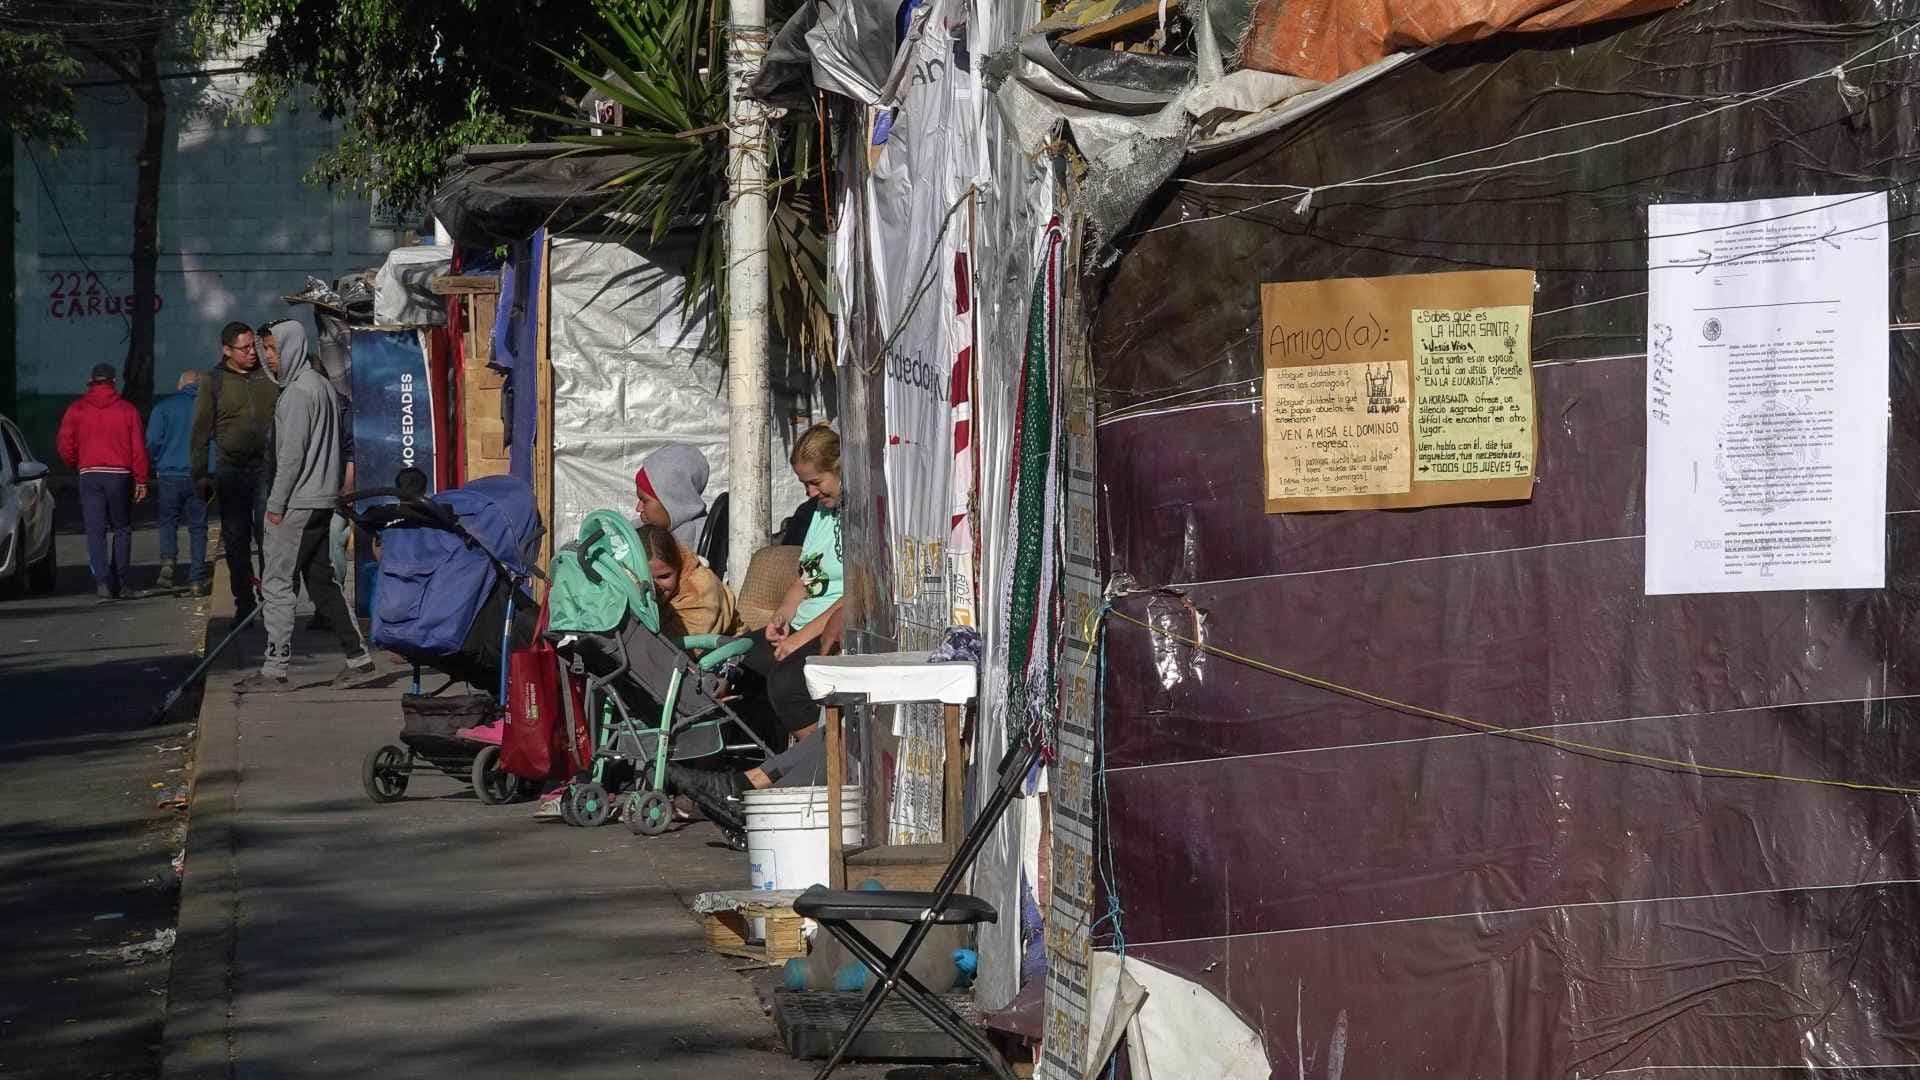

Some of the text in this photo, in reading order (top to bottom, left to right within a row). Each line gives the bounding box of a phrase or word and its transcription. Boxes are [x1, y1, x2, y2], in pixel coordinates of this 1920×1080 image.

[50, 271, 100, 299] 222
[1476, 312, 1487, 321] es
[1269, 311, 1389, 360] Amigo(a):
[1431, 324, 1444, 338] LA
[1448, 323, 1476, 338] HORA
[1420, 355, 1428, 365] La
[1440, 377, 1448, 386] LA
[1418, 396, 1428, 405] LA
[1418, 405, 1446, 414] silencio
[1450, 405, 1484, 416] sagrado
[1488, 404, 1504, 415] que
[1442, 415, 1453, 423] de
[1456, 414, 1490, 424] encontrar
[1510, 412, 1526, 422] otro
[1281, 422, 1399, 441] VEN A MISA EL DOMINGO
[1500, 439, 1512, 449] tus
[1460, 451, 1472, 460] tus
[1432, 463, 1459, 472] TODOS
[1462, 462, 1478, 473] LOS
[1480, 460, 1510, 472] JUEVES
